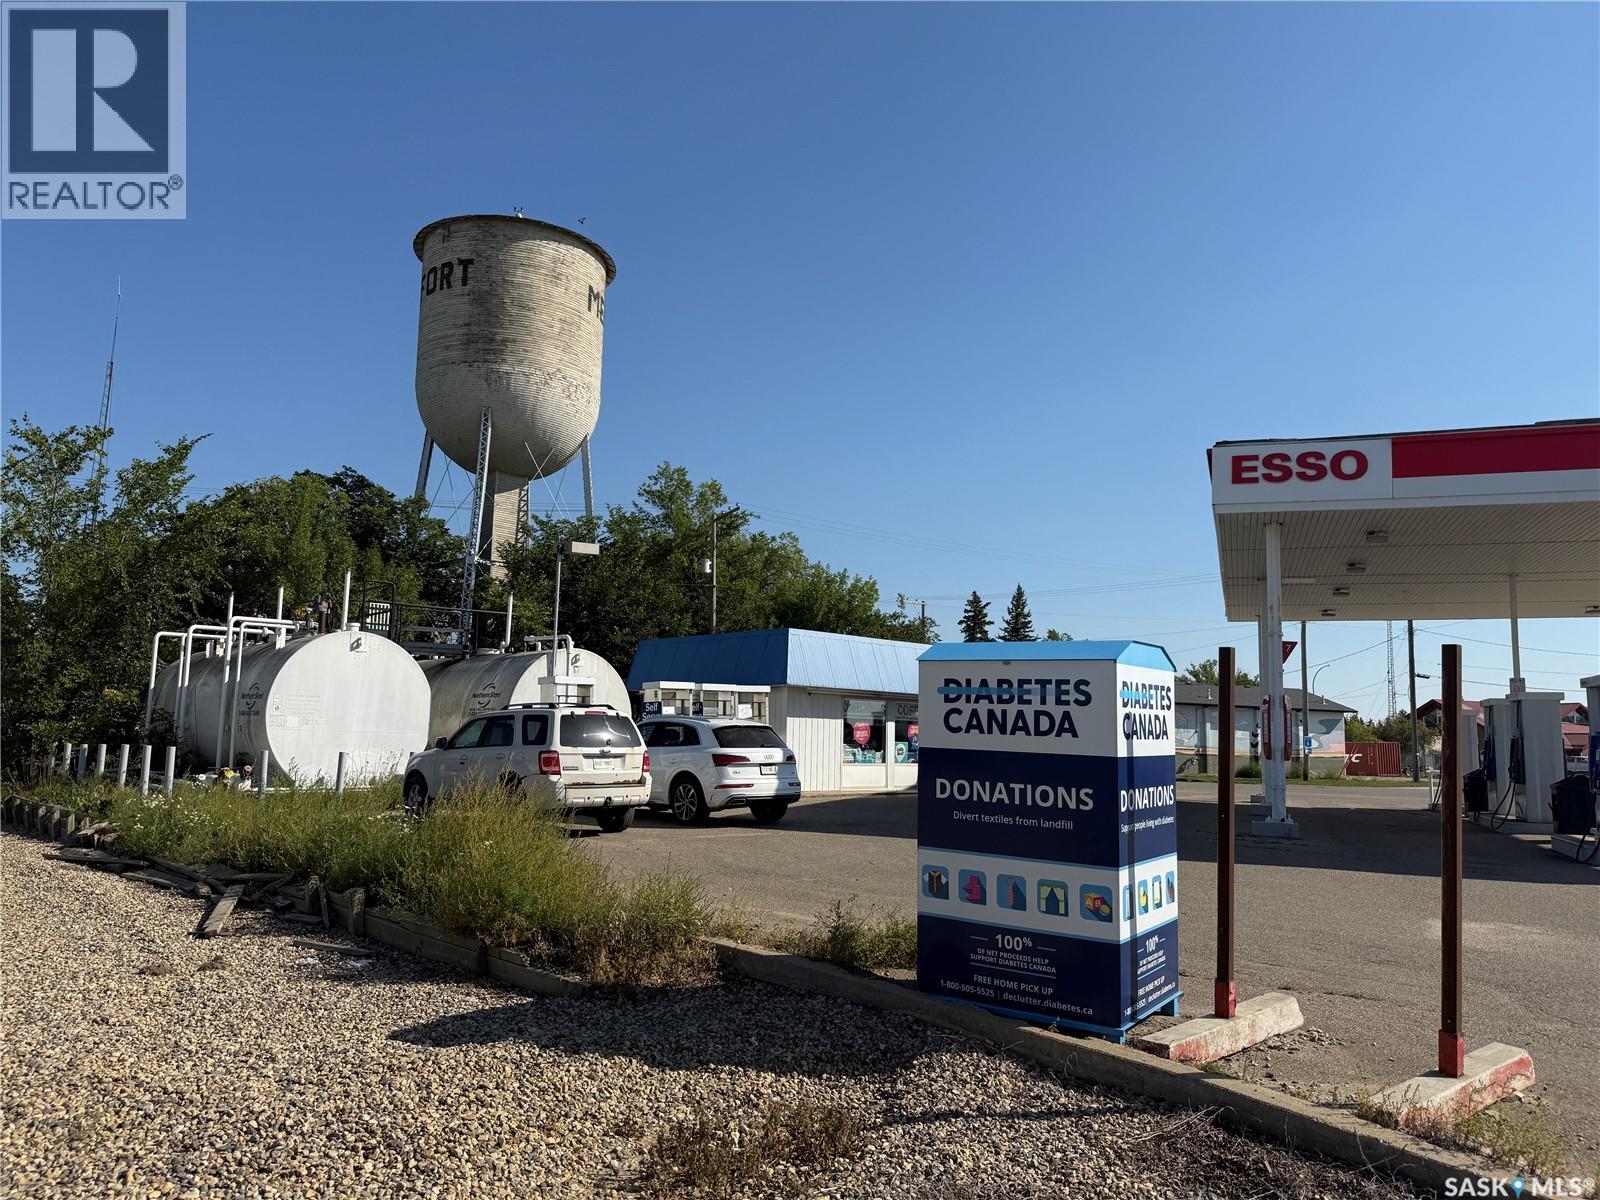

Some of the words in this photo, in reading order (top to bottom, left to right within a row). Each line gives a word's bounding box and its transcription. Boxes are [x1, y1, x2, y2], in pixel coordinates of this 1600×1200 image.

[1231, 450, 1369, 485] ESSO
[943, 678, 1092, 707] DIABETES
[1121, 681, 1172, 711] DIABETES
[645, 703, 658, 712] Self
[943, 708, 1079, 738] CANADA
[1122, 712, 1169, 740] CANADA
[935, 778, 1094, 811] DONATIONS
[1120, 785, 1174, 812] DONATIONS
[953, 811, 979, 822] Divert
[981, 812, 1013, 825] textiles
[1015, 815, 1038, 827] from
[1040, 817, 1073, 830] landfill
[1134, 821, 1146, 831] people
[1145, 819, 1155, 829] living
[1162, 815, 1174, 825] diabetes
[995, 934, 1032, 951] 100%
[970, 953, 997, 963] SUPPORT
[998, 957, 1028, 969] DIABETES
[1028, 963, 1056, 973] CANADA
[1000, 951, 1031, 962] PROCEEDS
[1032, 957, 1049, 965] HELP
[940, 979, 995, 998] 1-800-505-5525
[1003, 991, 1093, 1015] declutter.diabetes.ca
[973, 974, 992, 985] FREE
[993, 978, 1018, 990] HOME
[1020, 983, 1039, 993] PICK
[1041, 987, 1053, 996] UP
